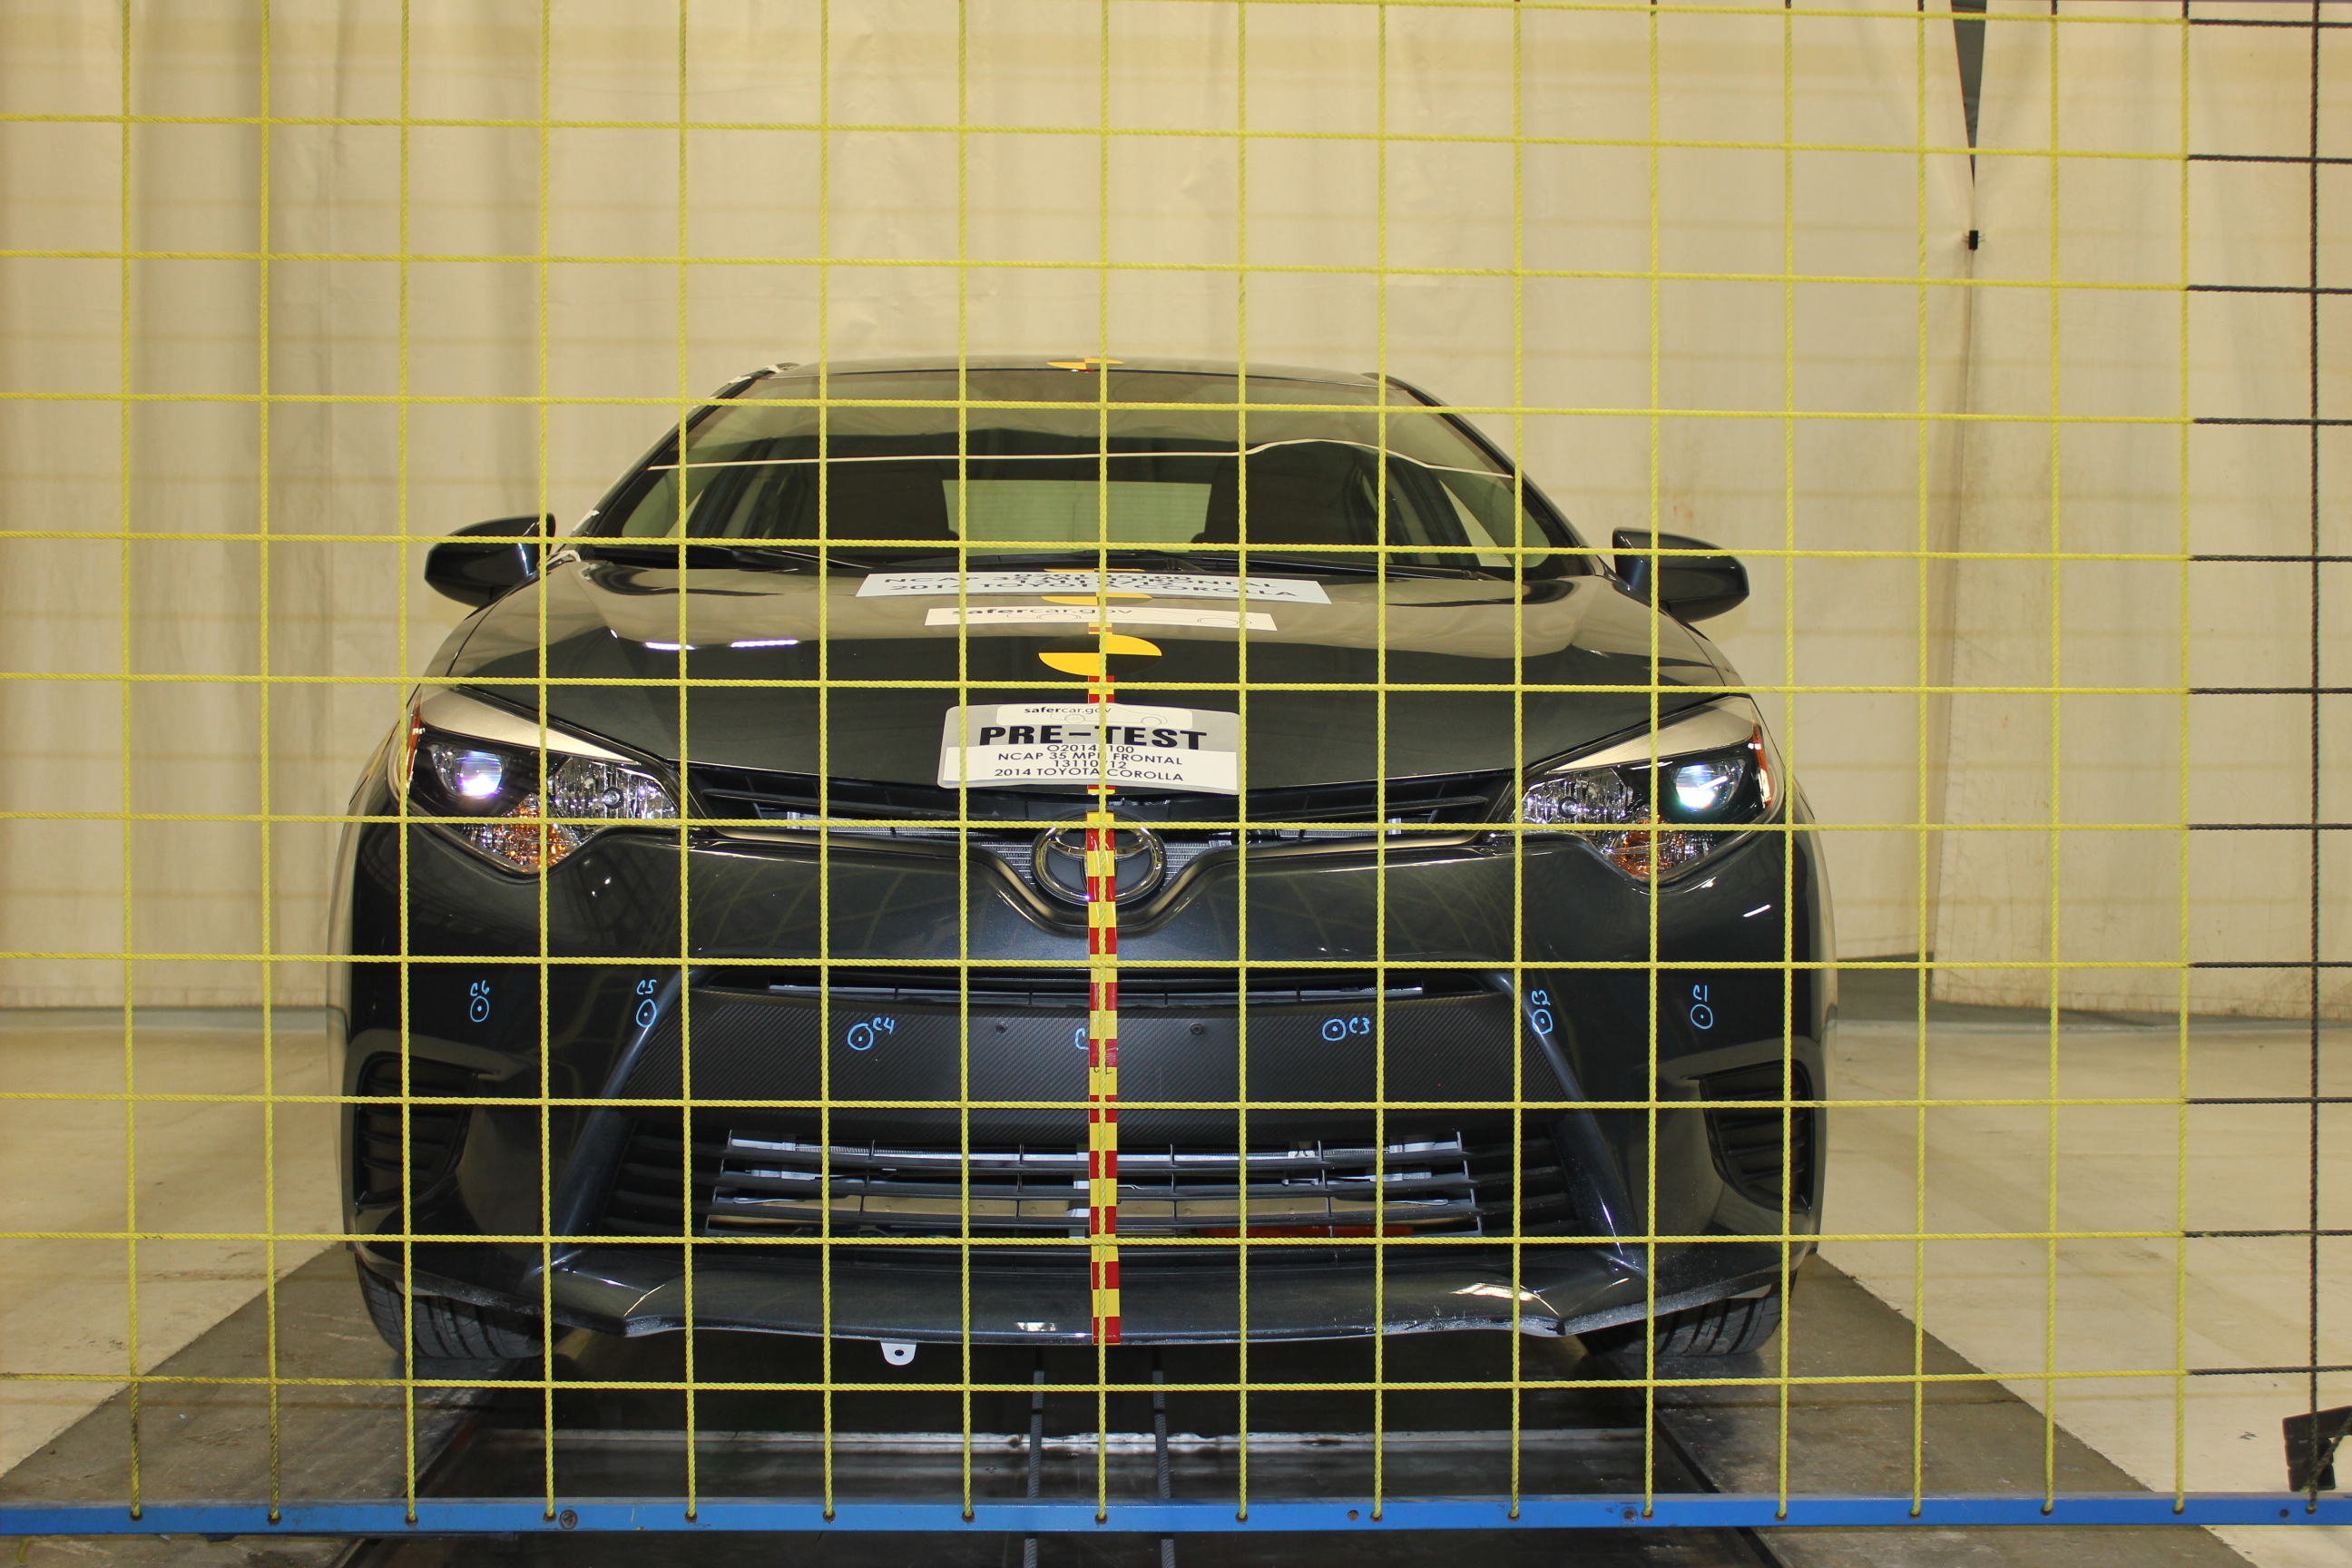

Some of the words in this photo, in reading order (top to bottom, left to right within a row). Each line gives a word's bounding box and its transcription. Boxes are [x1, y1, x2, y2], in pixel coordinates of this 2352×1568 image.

[1133, 584, 1298, 597] COROLLA
[1024, 706, 1112, 714] safercar.gov
[979, 724, 1208, 751] PRE-TEST
[998, 752, 1044, 760] NCAP
[1049, 751, 1067, 760] 35
[1112, 752, 1183, 766] FRONTAL
[1054, 760, 1127, 769] 1311012
[995, 769, 1031, 777] 2014
[1036, 768, 1100, 777] TOYOTA
[1106, 769, 1184, 781] COROLLA
[636, 978, 657, 995] C5
[1531, 989, 1552, 1006] C2
[872, 1016, 896, 1035] C4
[1348, 1017, 1371, 1035] C3
